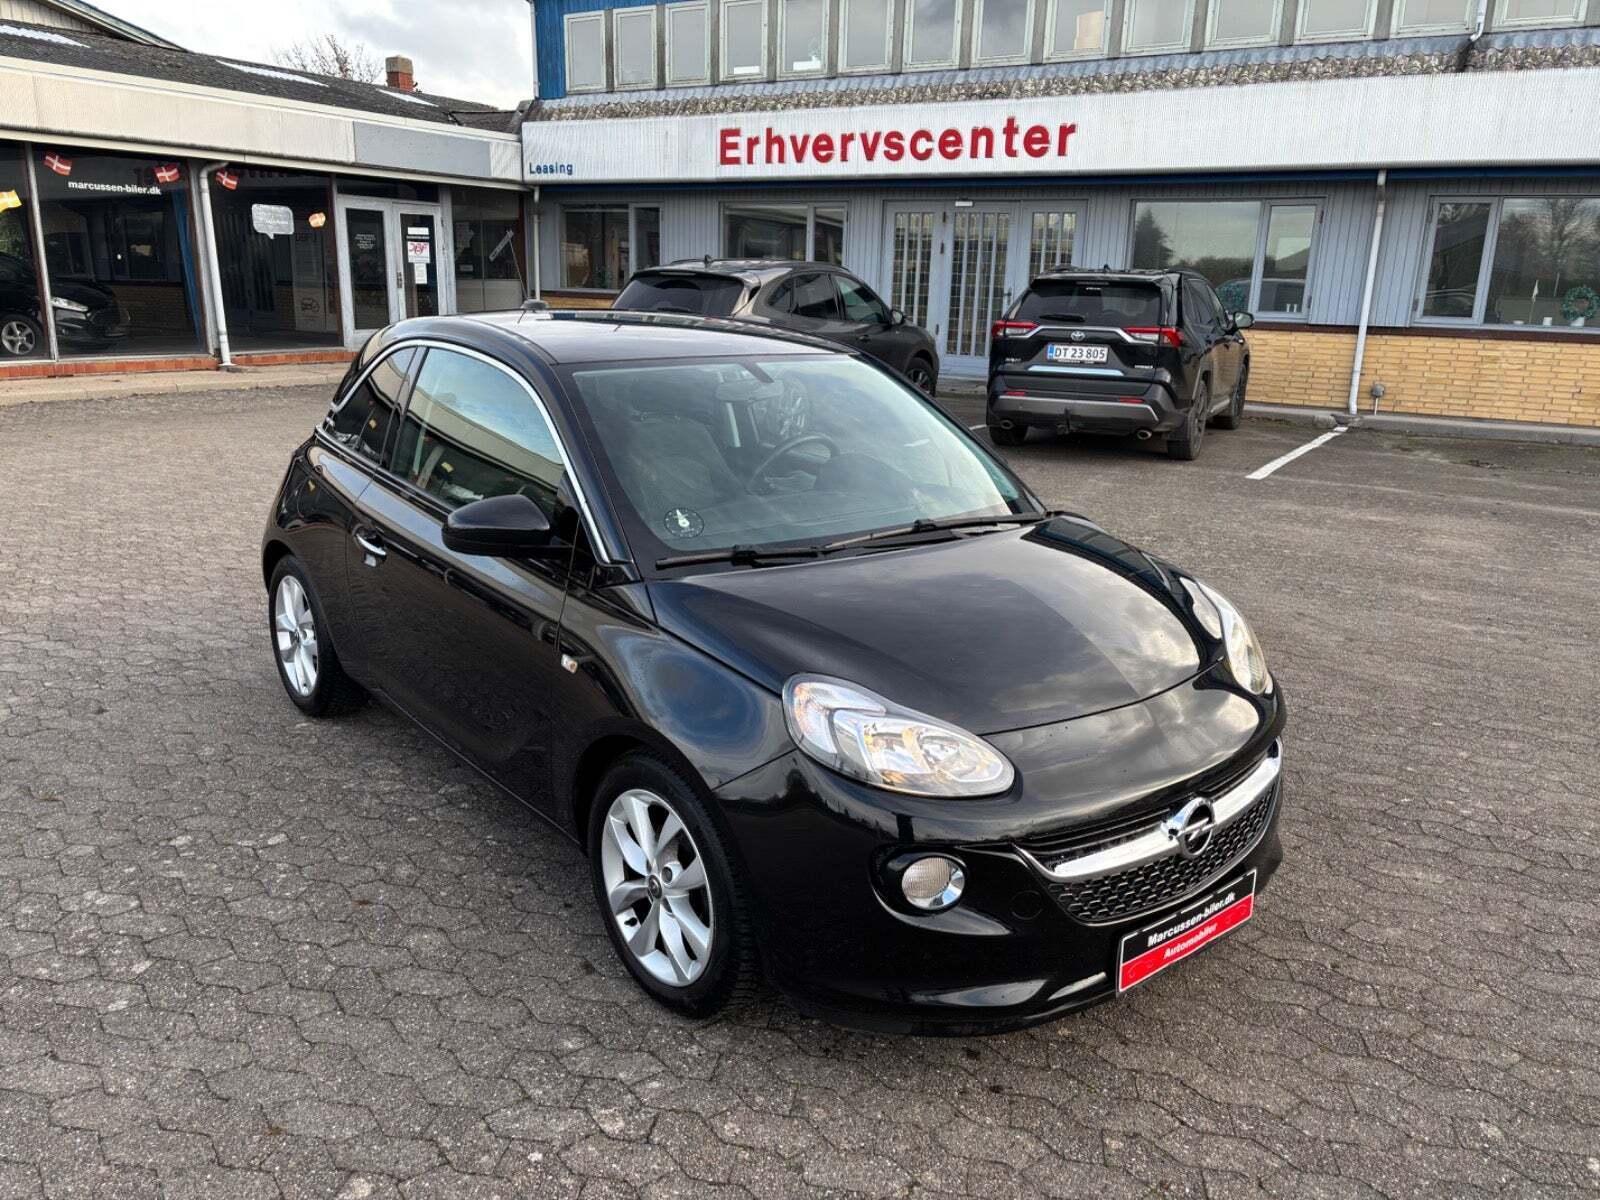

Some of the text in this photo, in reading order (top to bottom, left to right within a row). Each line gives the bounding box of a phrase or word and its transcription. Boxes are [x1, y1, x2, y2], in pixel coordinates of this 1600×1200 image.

[719, 116, 1076, 165] Erhvervscenter
[529, 161, 573, 176] Leasing
[67, 181, 162, 195] marcussen-biler.dk
[1054, 347, 1106, 359] DT 23 805
[1147, 892, 1236, 947] Marcussen-biler.dk
[1164, 923, 1218, 959] Automobiler
